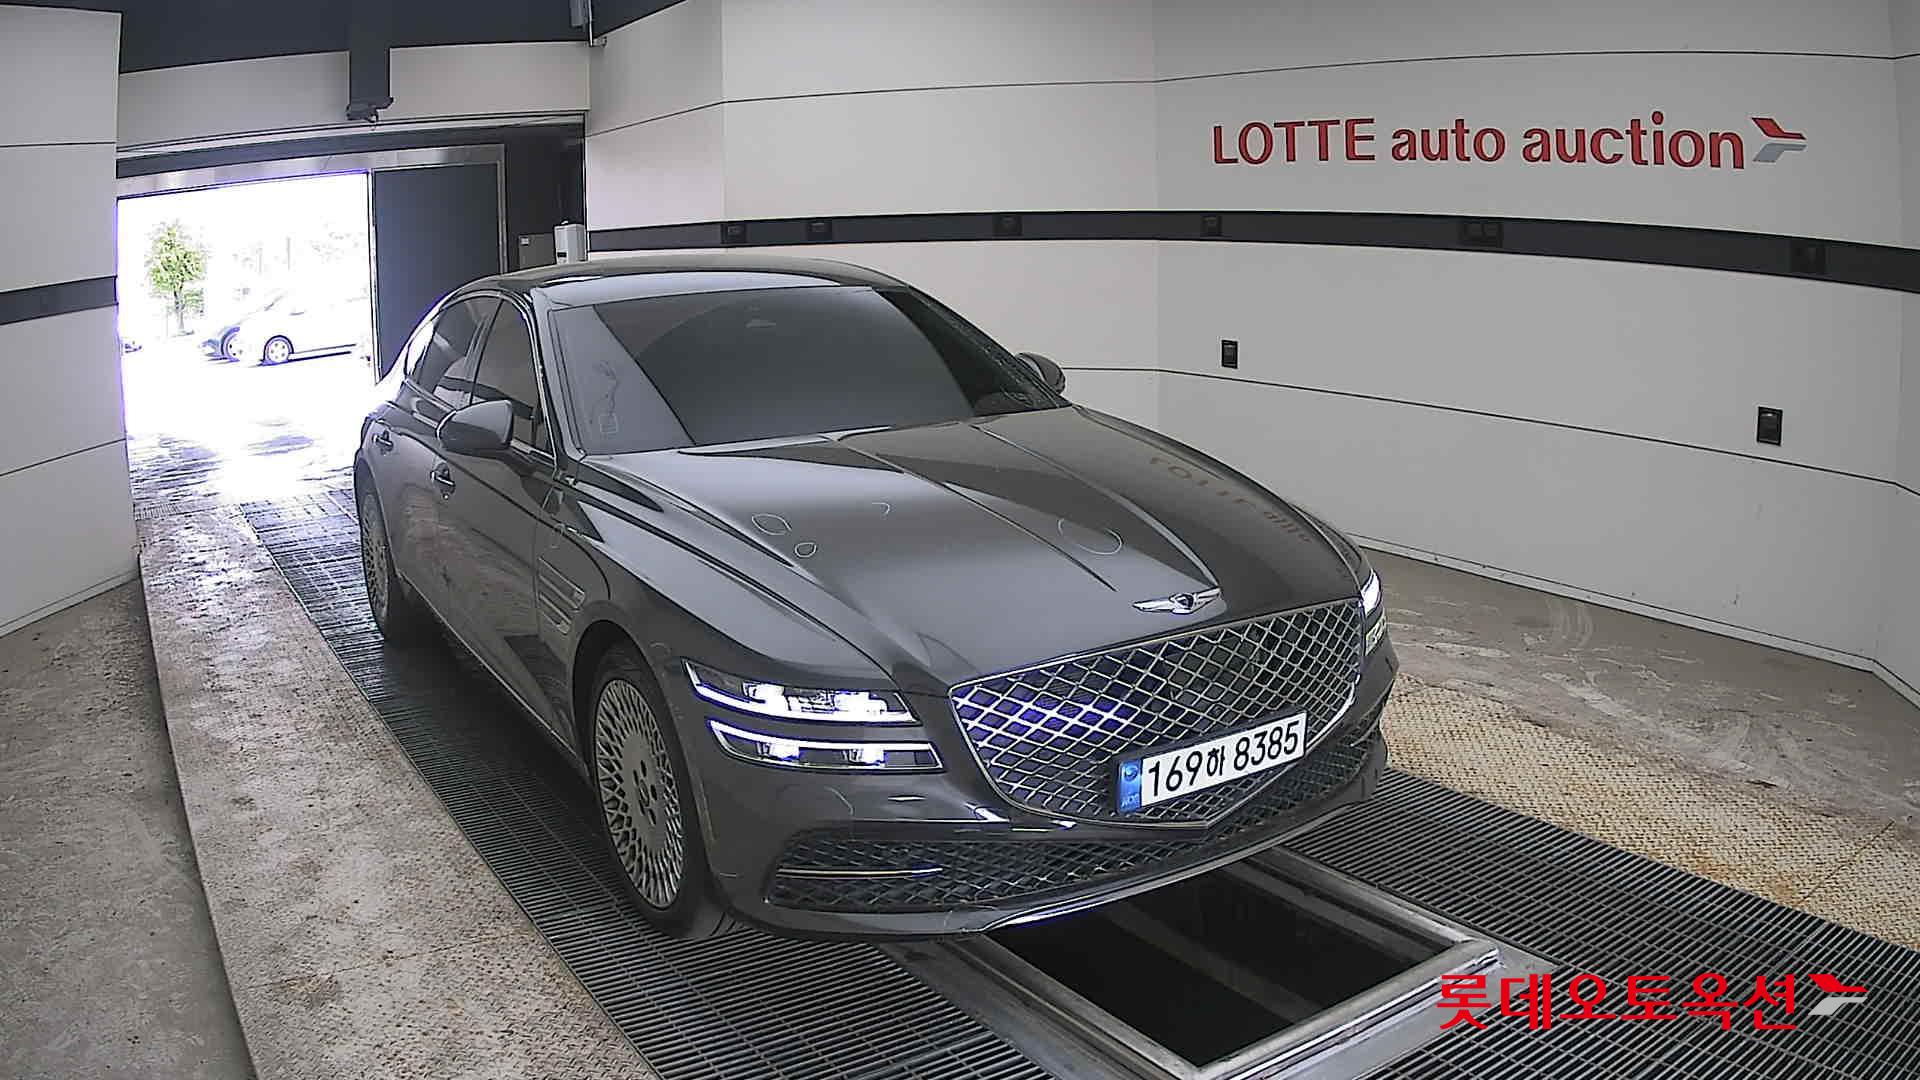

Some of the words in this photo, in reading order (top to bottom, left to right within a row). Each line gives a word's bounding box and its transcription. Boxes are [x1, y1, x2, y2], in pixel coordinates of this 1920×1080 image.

[1213, 118, 1376, 164] LOTTE
[1391, 118, 1507, 162] auto
[1521, 111, 1746, 170] auction
[1148, 745, 1226, 797] 169하
[1233, 720, 1300, 771] 8385
